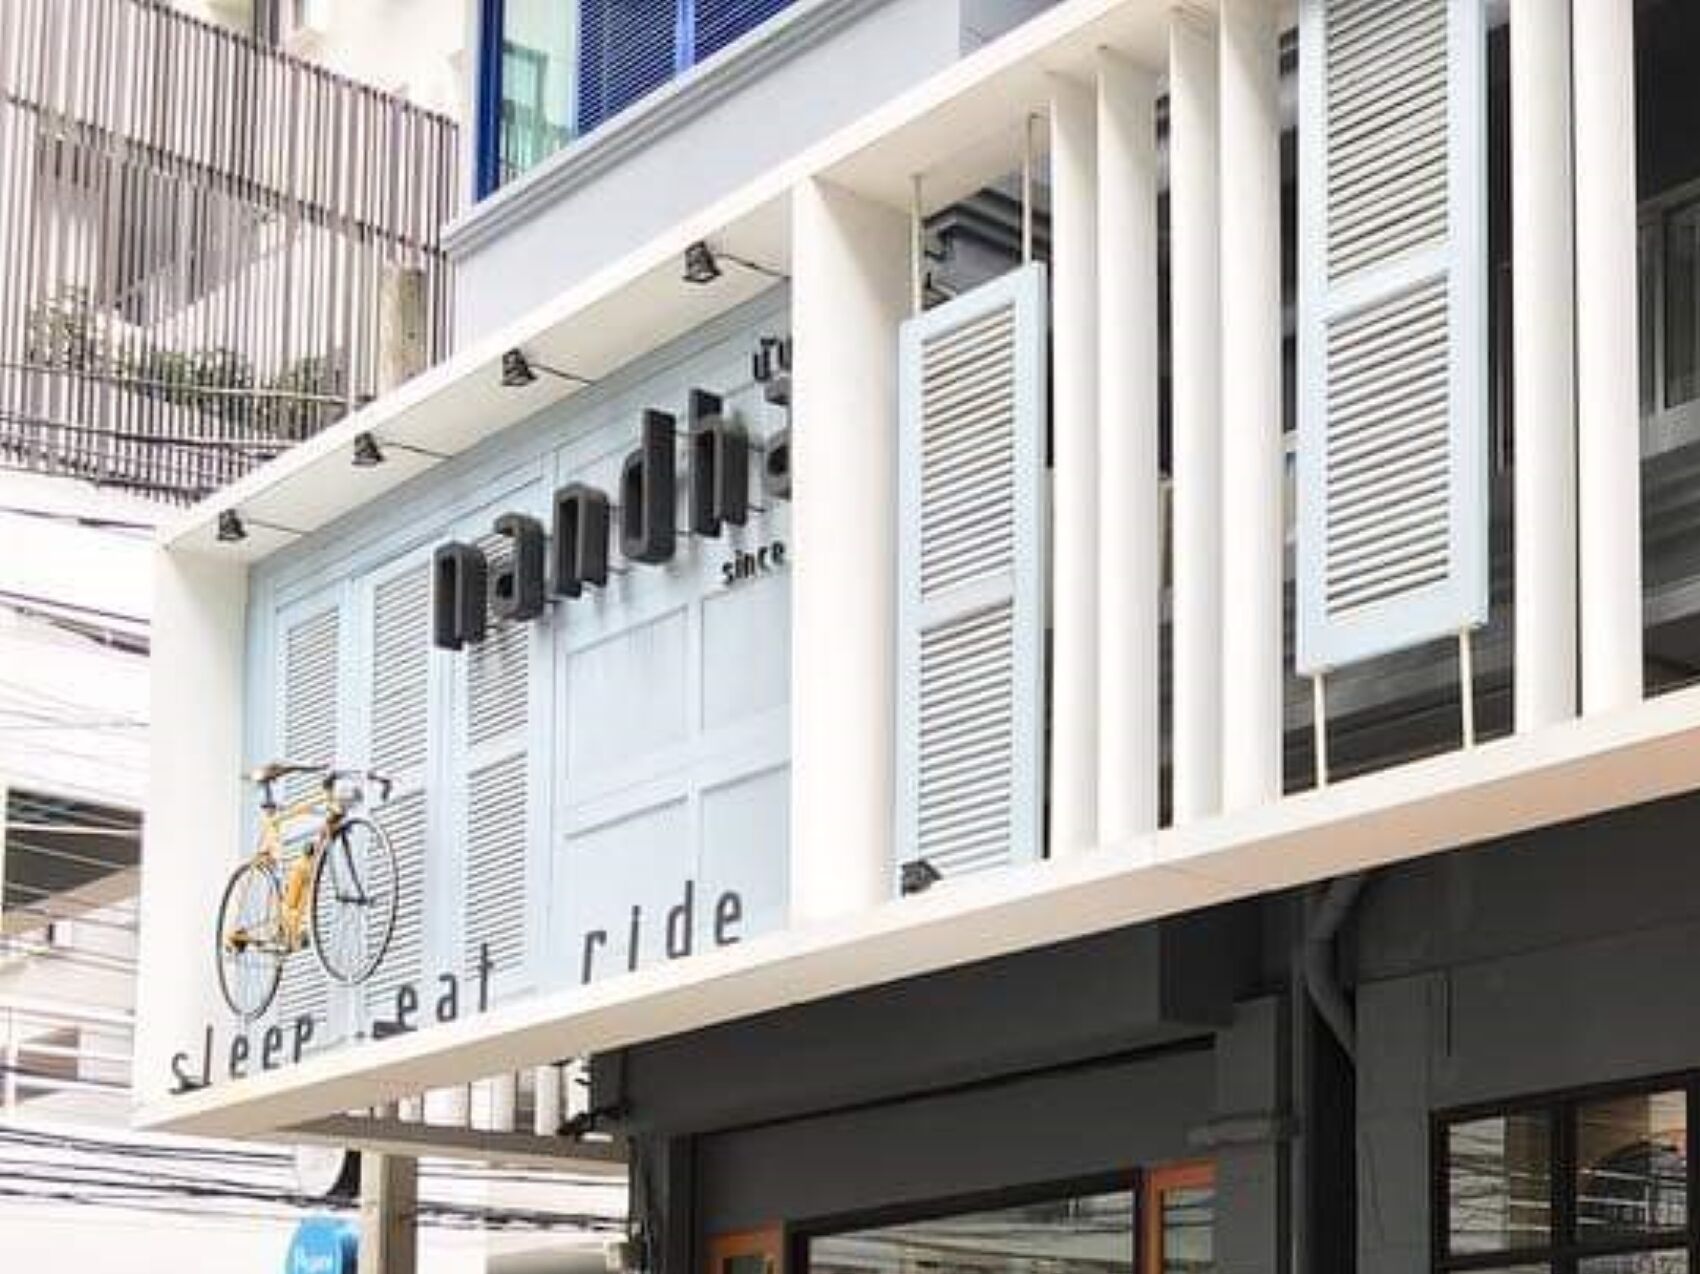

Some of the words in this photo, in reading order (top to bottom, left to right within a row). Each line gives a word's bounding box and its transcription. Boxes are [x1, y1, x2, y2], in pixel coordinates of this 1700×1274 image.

[168, 1014, 315, 1096] sleep
[396, 940, 494, 1032] eat
[580, 879, 743, 984] ride
